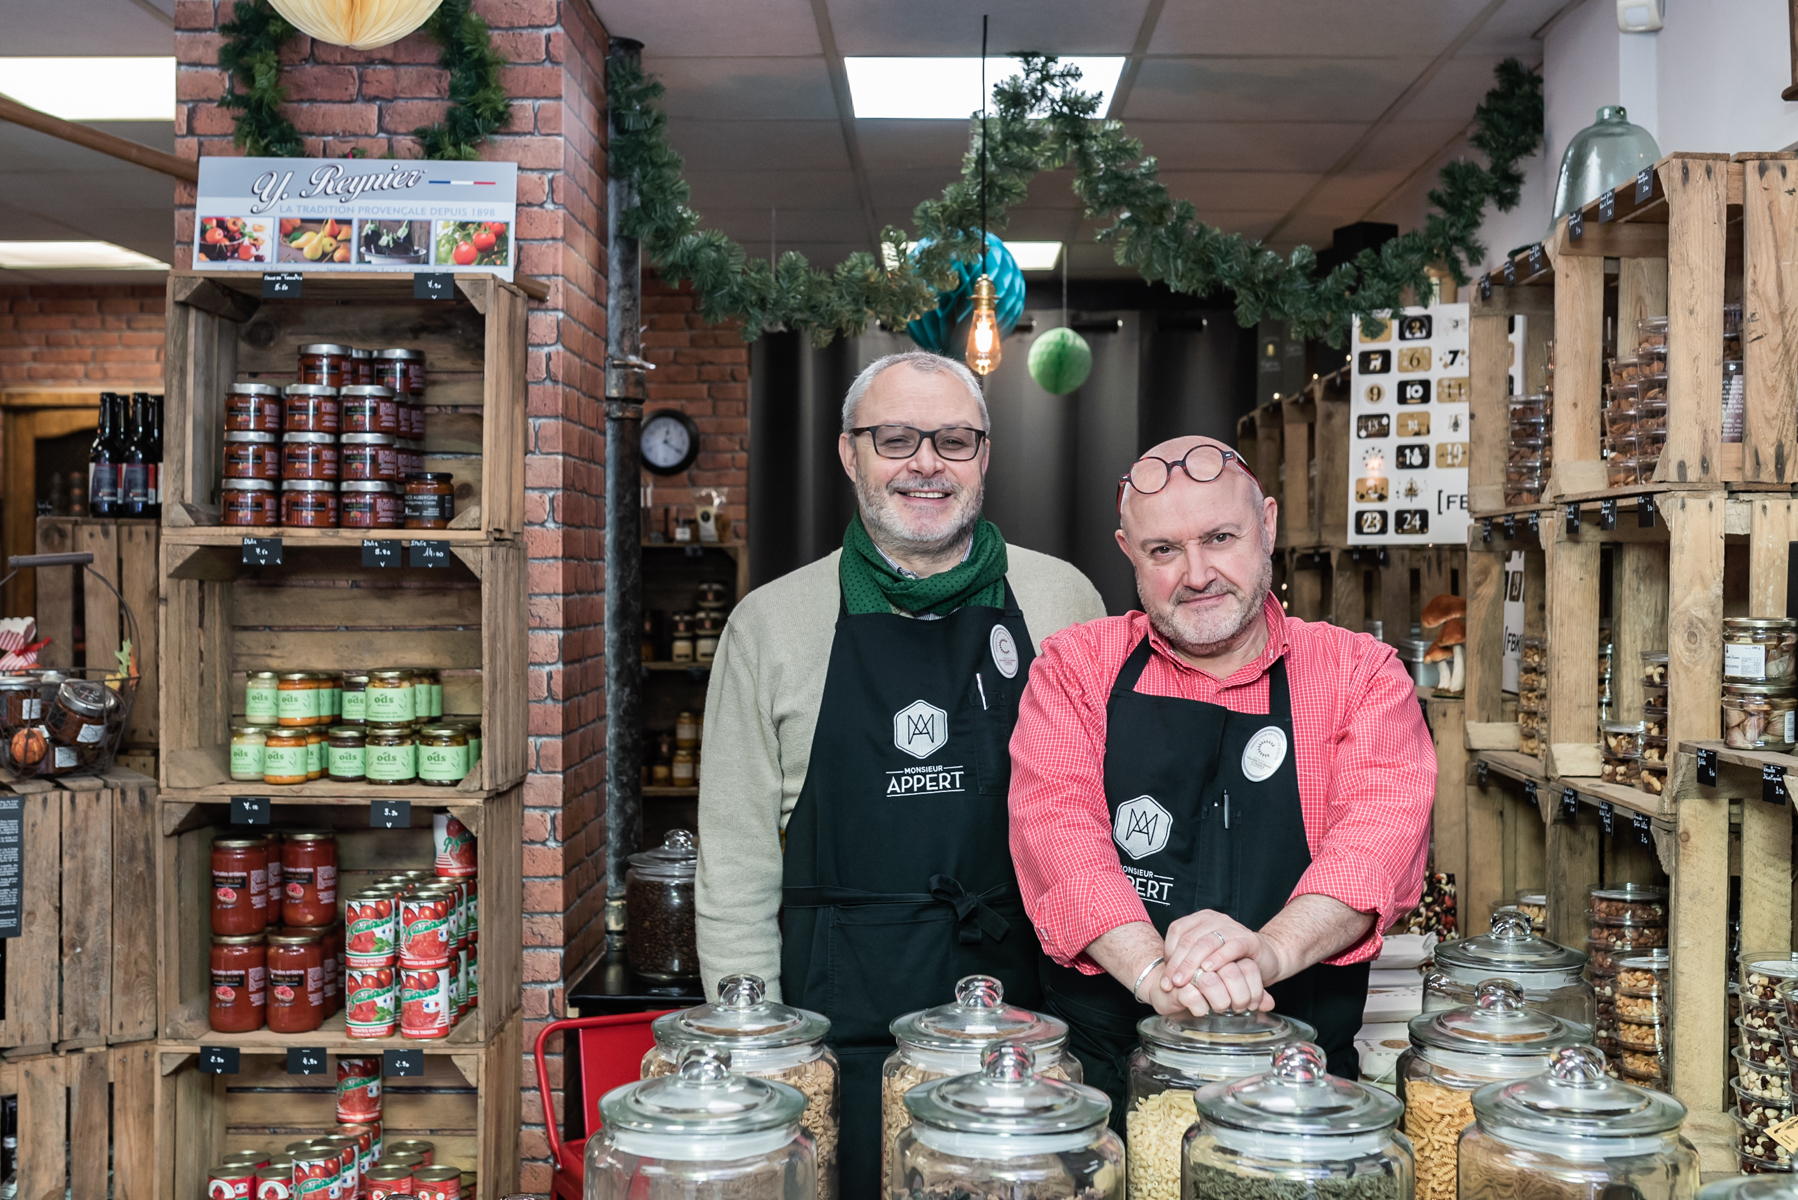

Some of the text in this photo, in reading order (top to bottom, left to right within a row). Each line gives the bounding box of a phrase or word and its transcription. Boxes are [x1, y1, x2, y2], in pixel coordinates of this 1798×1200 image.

[300, 163, 423, 203] Reynier
[279, 204, 495, 217] LA TRADITION PROVENÇALE DEPUIS 1898
[1411, 320, 1420, 333] 2
[1409, 351, 1421, 369] 6
[1448, 350, 1460, 366] 7
[1369, 386, 1381, 401] 9
[1406, 384, 1424, 399] 10
[1446, 444, 1463, 467] 19
[1363, 512, 1382, 533] 23
[1403, 513, 1421, 530] 24
[904, 765, 943, 775] MONSIEUR
[887, 772, 964, 794] APPERT
[1120, 865, 1154, 878] ONSIEUR
